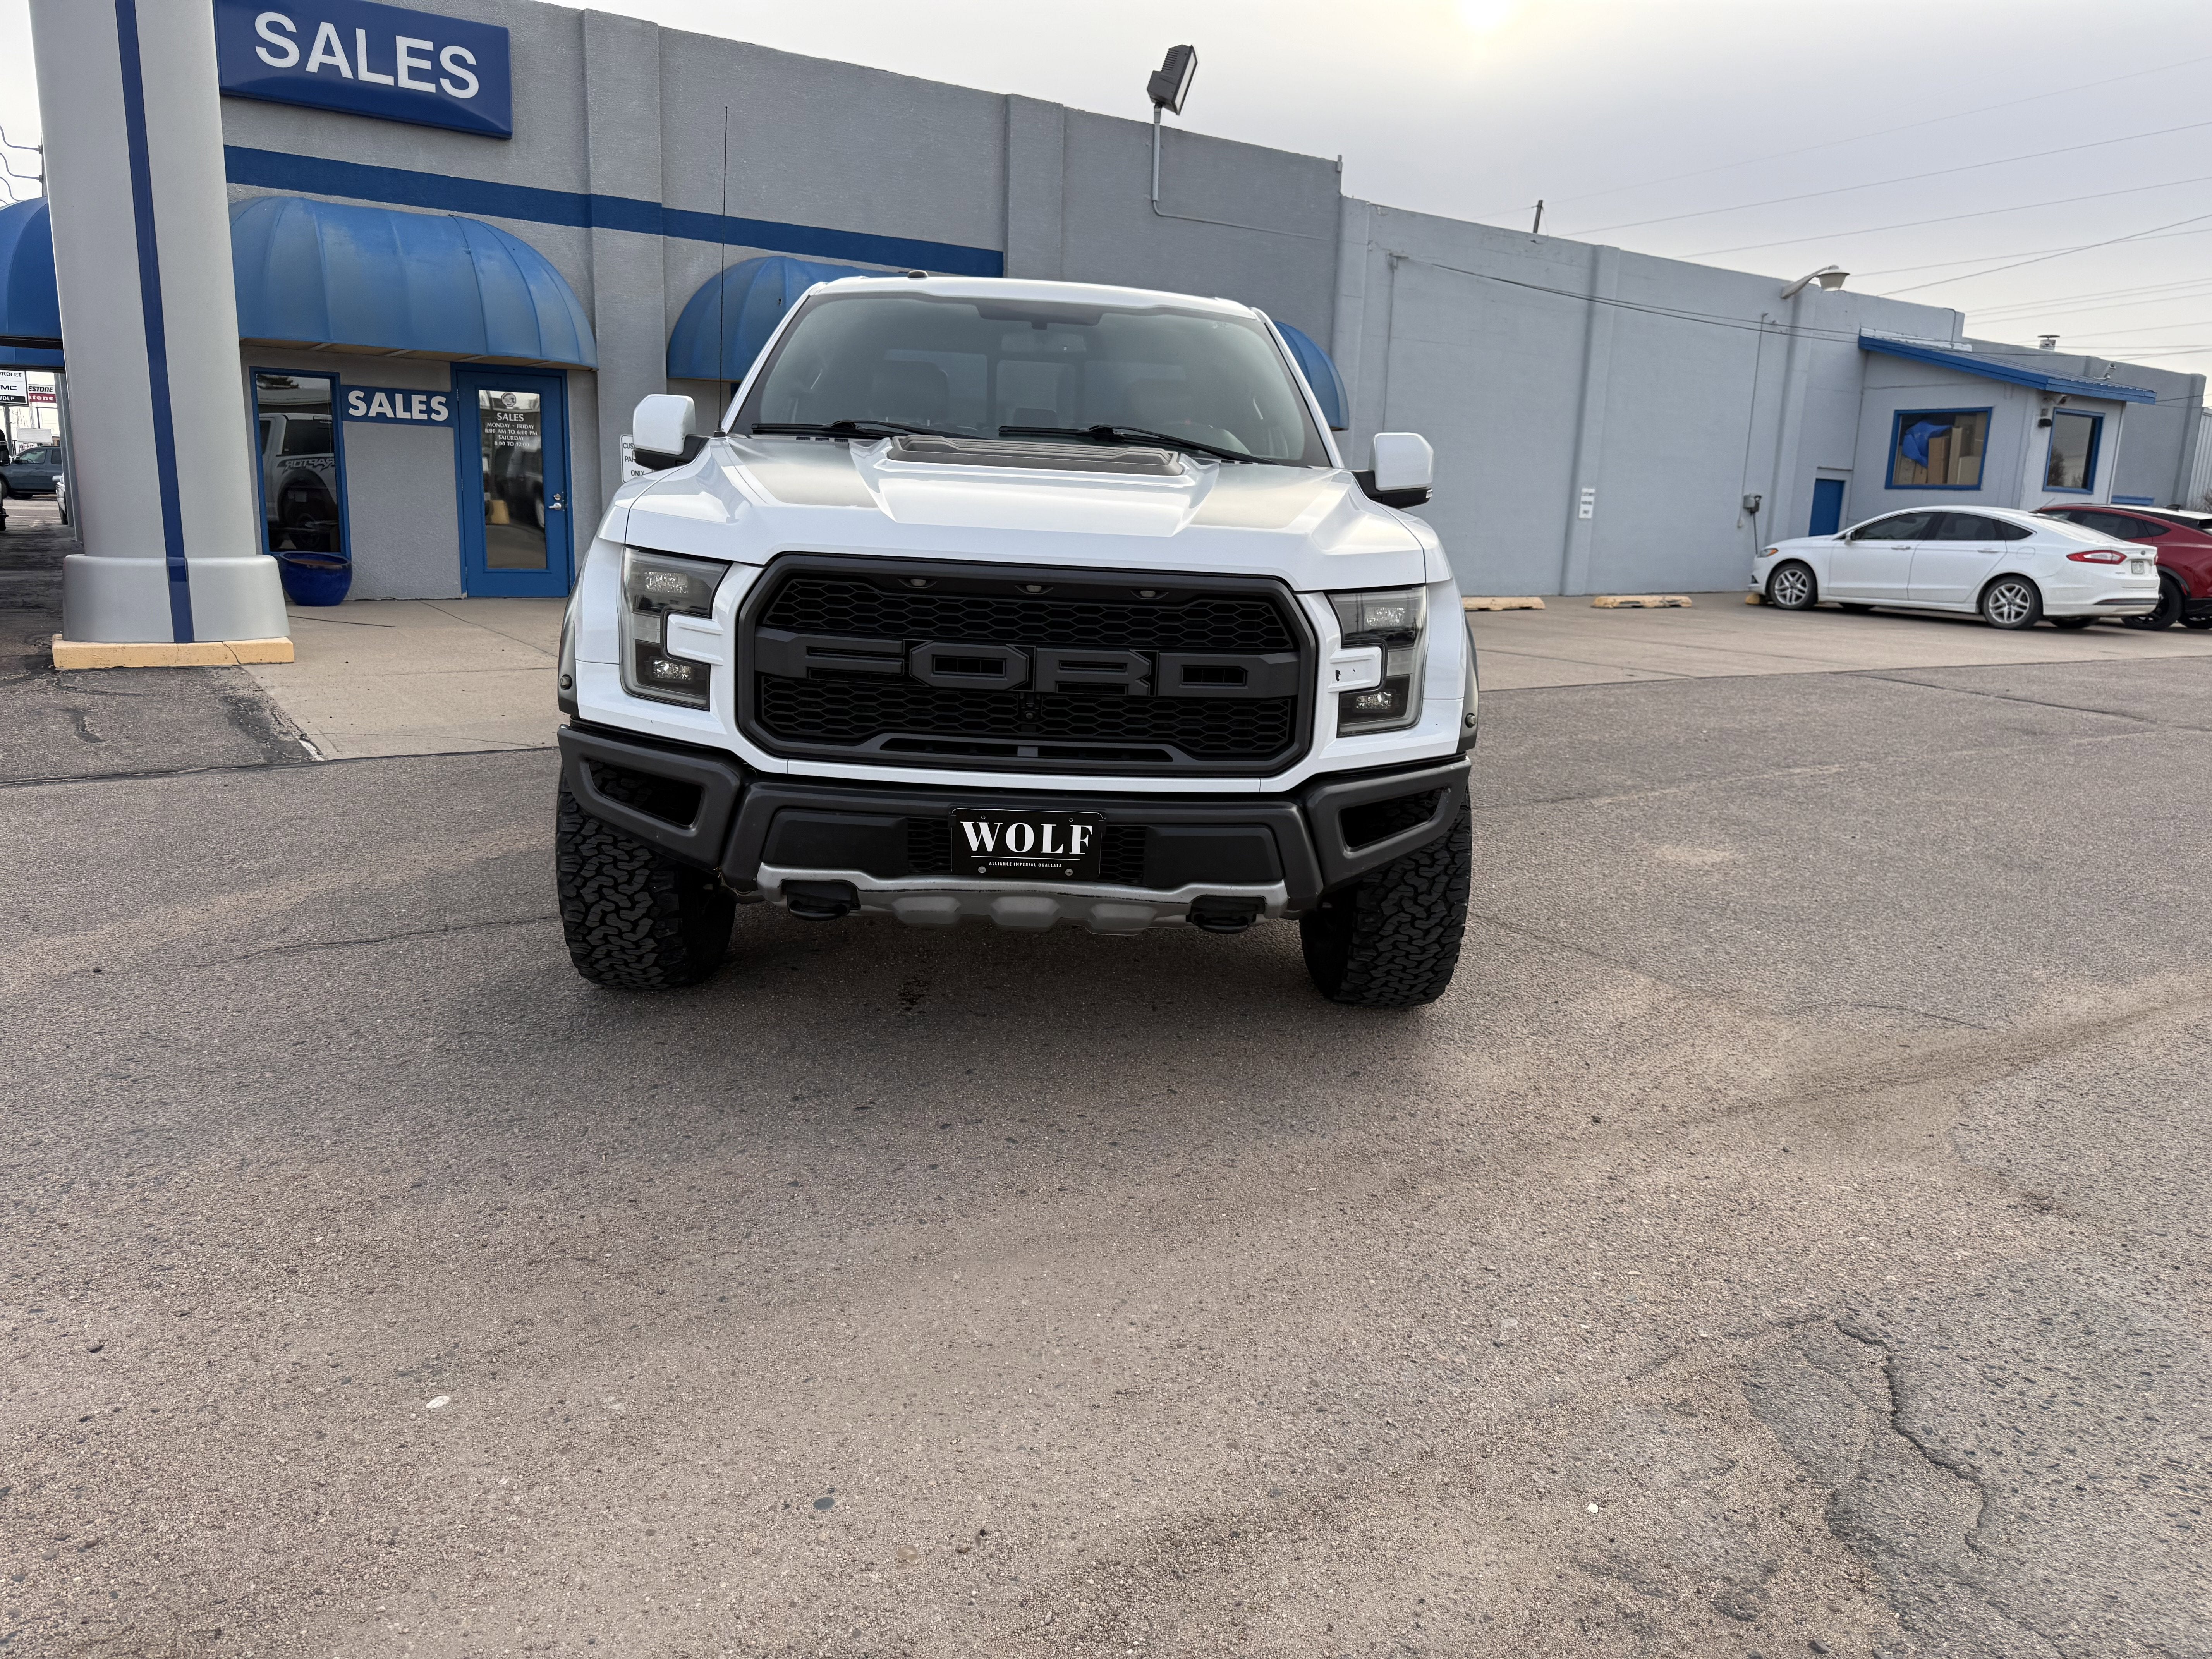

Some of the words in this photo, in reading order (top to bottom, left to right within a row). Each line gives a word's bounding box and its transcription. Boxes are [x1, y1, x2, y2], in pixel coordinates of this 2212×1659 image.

[254, 12, 479, 99] SALES
[348, 390, 448, 421] SALES
[497, 412, 524, 422] SALES
[755, 626, 1300, 698] FORD
[960, 821, 1092, 854] WOLF
